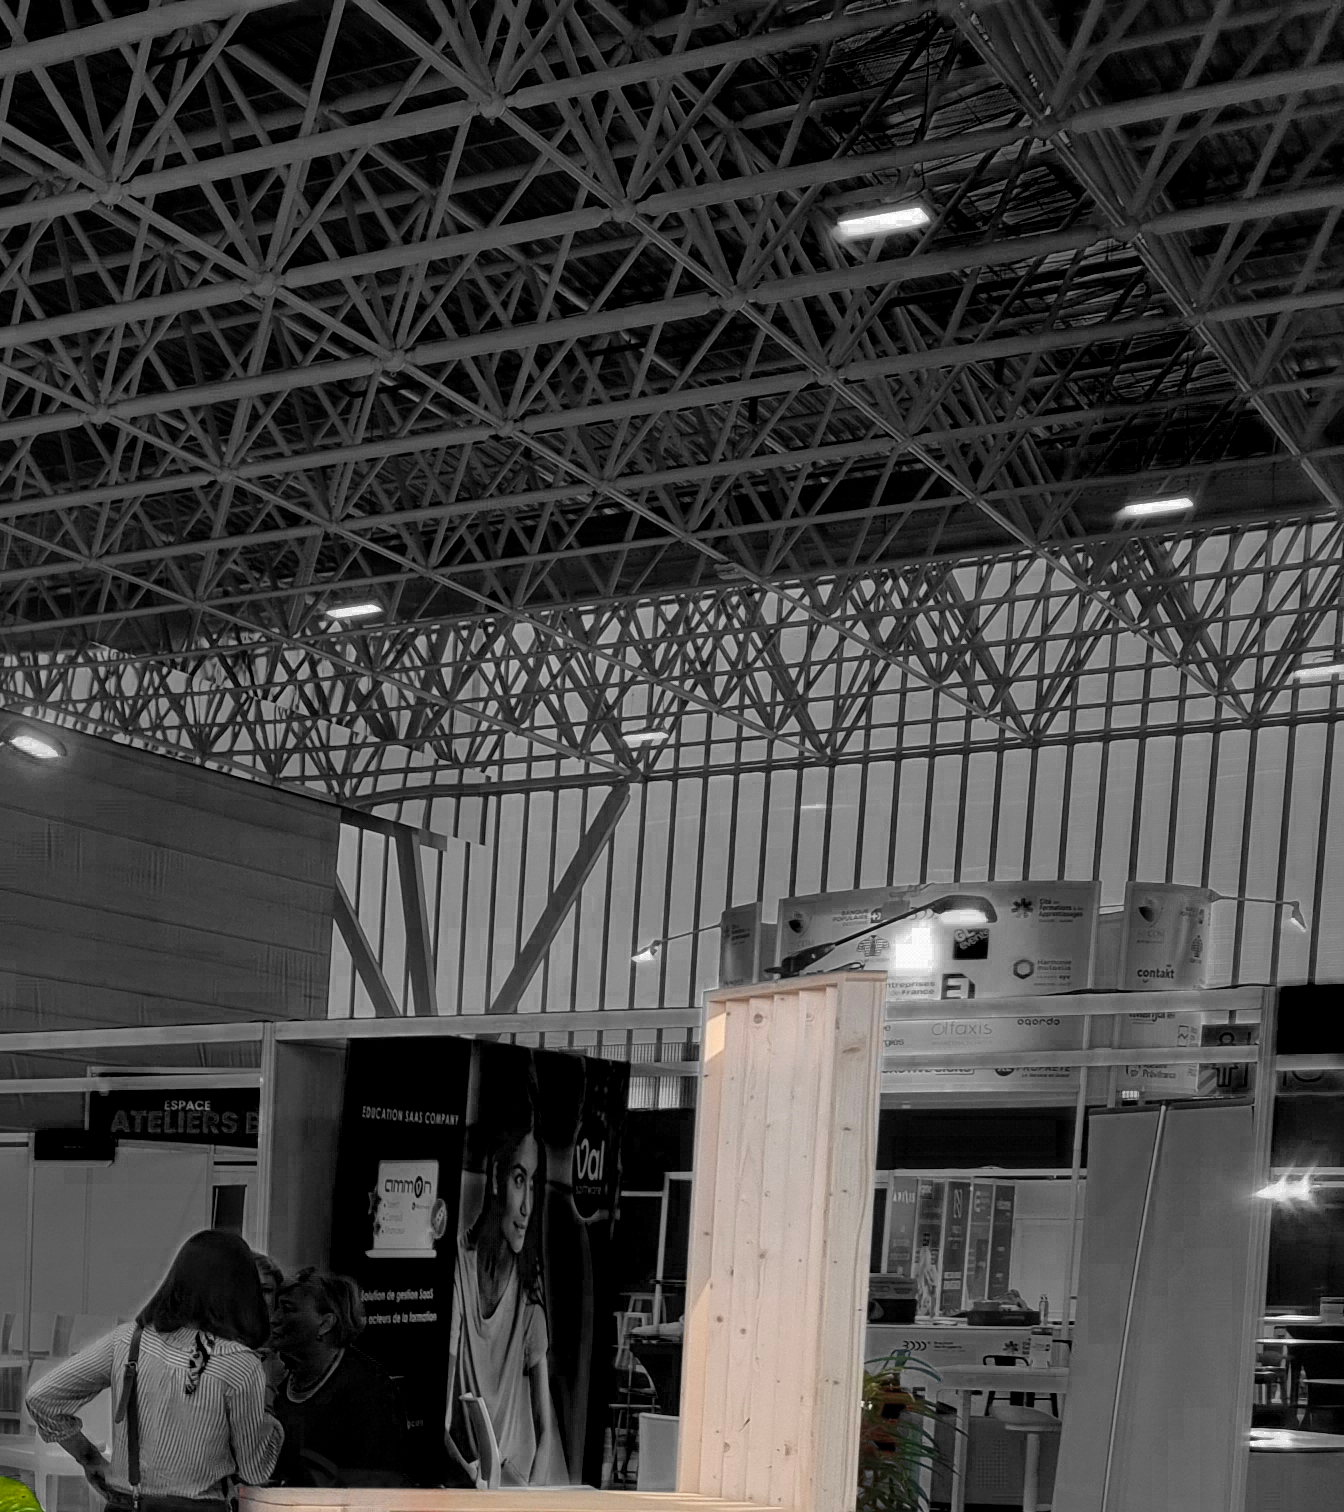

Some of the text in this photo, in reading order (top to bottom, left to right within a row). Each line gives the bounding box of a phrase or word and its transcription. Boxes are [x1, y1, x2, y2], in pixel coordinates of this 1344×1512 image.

[1137, 966, 1174, 980] contakt
[886, 981, 935, 990] ntreprises
[164, 1100, 211, 1111] ESPACE
[110, 1110, 240, 1134] ATELIERS
[362, 1105, 459, 1126] EDUCATION SAAS COMPANY
